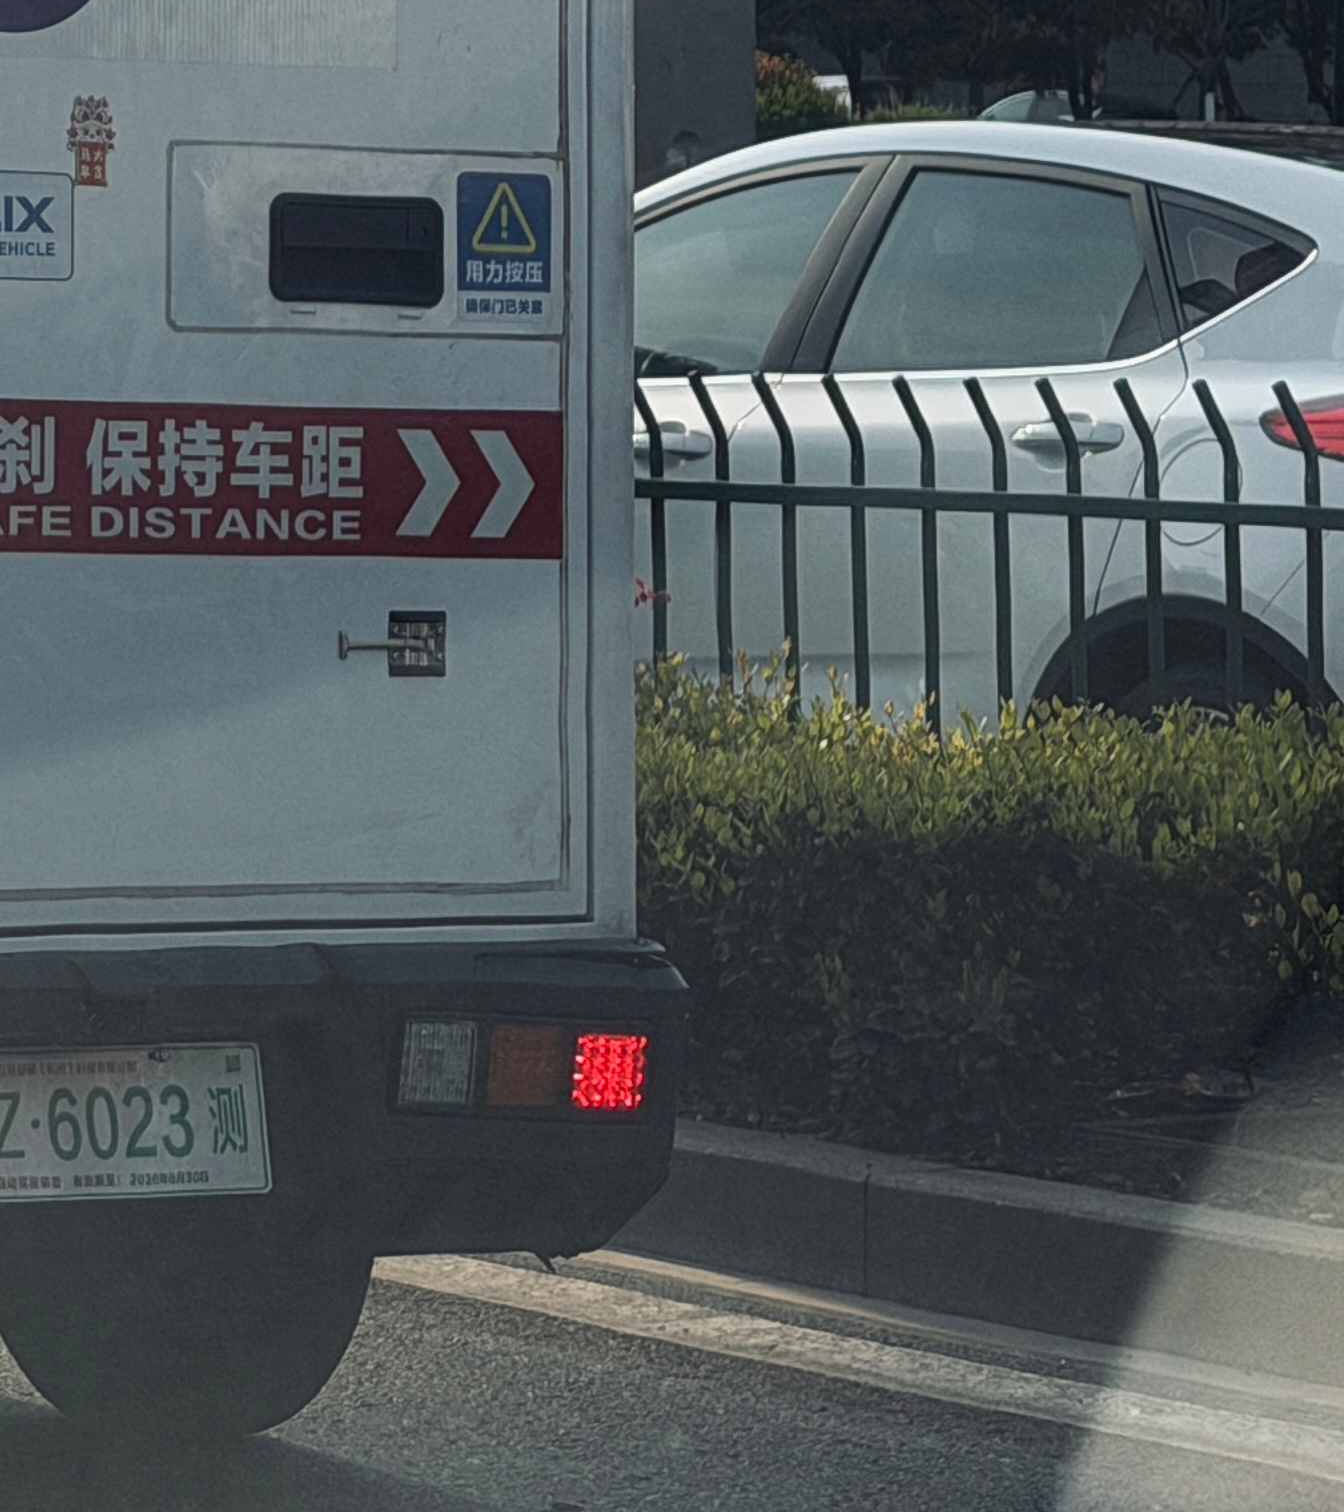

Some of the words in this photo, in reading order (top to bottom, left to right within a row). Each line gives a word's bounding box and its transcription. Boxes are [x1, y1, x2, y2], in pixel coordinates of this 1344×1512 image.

[465, 259, 544, 284] 用力按压
[86, 418, 365, 499] 保持车距
[90, 506, 362, 541] DISTANCE
